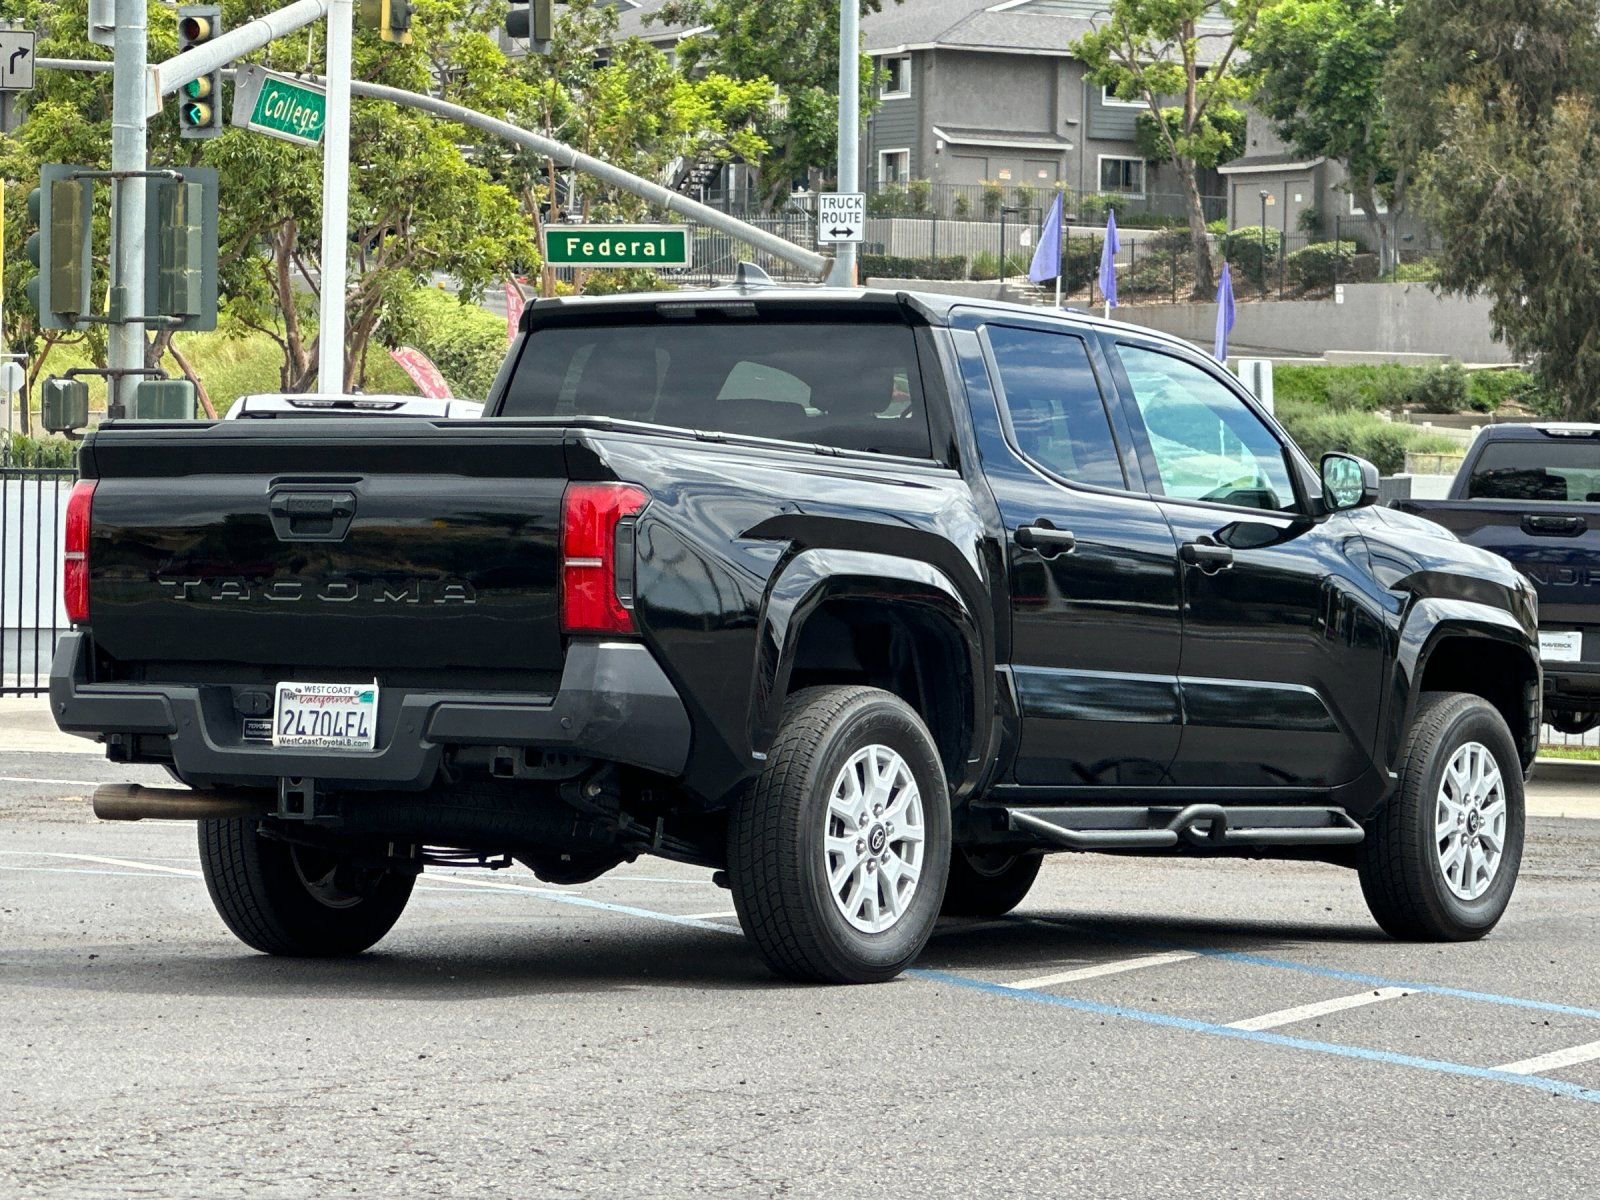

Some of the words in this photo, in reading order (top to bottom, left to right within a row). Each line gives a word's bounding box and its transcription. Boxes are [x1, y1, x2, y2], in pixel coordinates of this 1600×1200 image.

[265, 90, 319, 135] College
[821, 197, 862, 209] TRUCK
[821, 212, 861, 224] ROUTE
[566, 237, 666, 257] Federal
[157, 577, 477, 604] TACOMA
[304, 685, 325, 694] WEST
[326, 686, 352, 695] COAST
[299, 695, 354, 708] California
[283, 709, 368, 737] 24704F4
[278, 736, 369, 748] WestCoastToyotaLB.com
